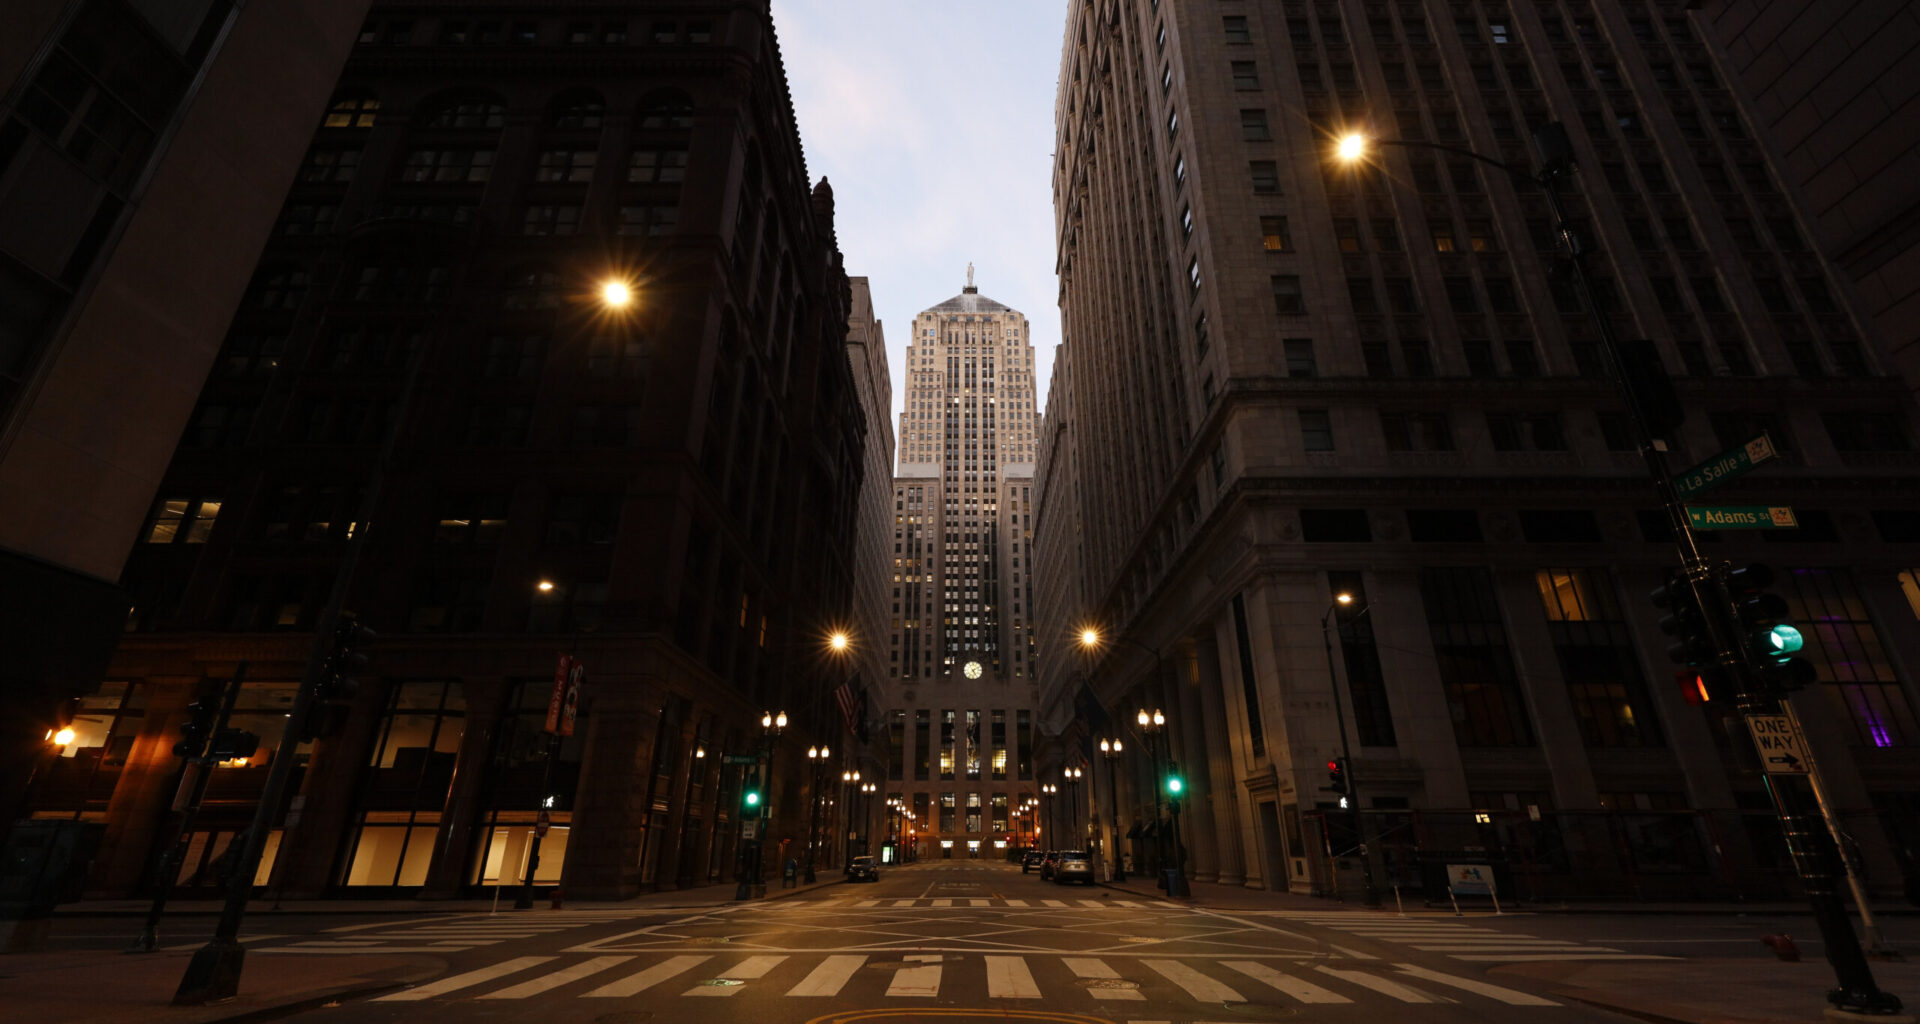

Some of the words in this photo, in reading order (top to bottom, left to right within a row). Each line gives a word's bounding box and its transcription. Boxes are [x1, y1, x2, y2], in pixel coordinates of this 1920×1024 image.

[1685, 476, 1703, 491] La
[1703, 458, 1738, 482] Salle
[1692, 513, 1701, 521] W
[1705, 509, 1757, 524] Adams
[1755, 720, 1789, 733] ONE
[1758, 735, 1793, 749] WAY
